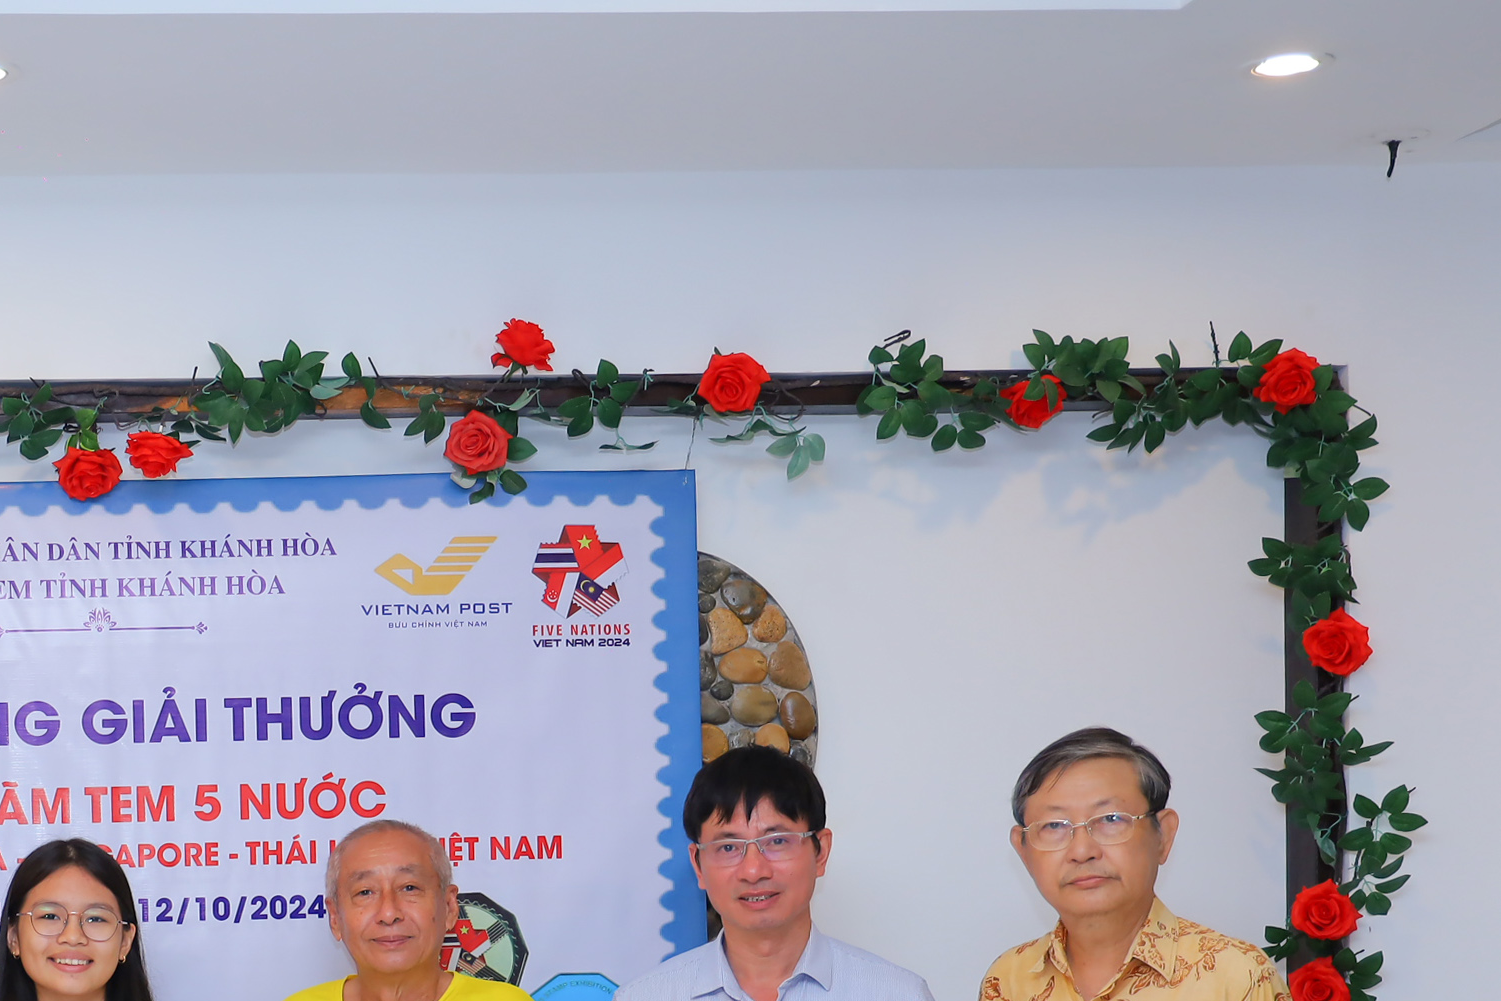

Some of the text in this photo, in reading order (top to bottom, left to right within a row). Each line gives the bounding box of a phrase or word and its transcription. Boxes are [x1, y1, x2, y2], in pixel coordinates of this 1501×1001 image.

[47, 537, 100, 562] DÂN
[108, 535, 172, 561] TỈNH
[179, 534, 274, 559] KHÁNH
[281, 535, 338, 557] HÒA
[41, 573, 108, 599] TỈNH
[116, 570, 217, 598] KHÁNH
[225, 570, 286, 596] HÒA
[361, 602, 513, 616] VIETNAM POST
[411, 620, 442, 628] CHÍNH
[445, 619, 464, 628] VIỆT
[533, 624, 631, 636] FIVE NATIONS
[533, 638, 631, 648] VIET NAM 2024
[80, 686, 208, 744] GIẢI
[222, 682, 477, 742] THƯỞNG
[84, 785, 175, 824] TEM
[194, 784, 222, 822] 5
[239, 772, 387, 820] NƯỚC
[245, 834, 317, 865] THÁI
[490, 835, 562, 860] NAM
[570, 980, 613, 994] EXHIBITION
